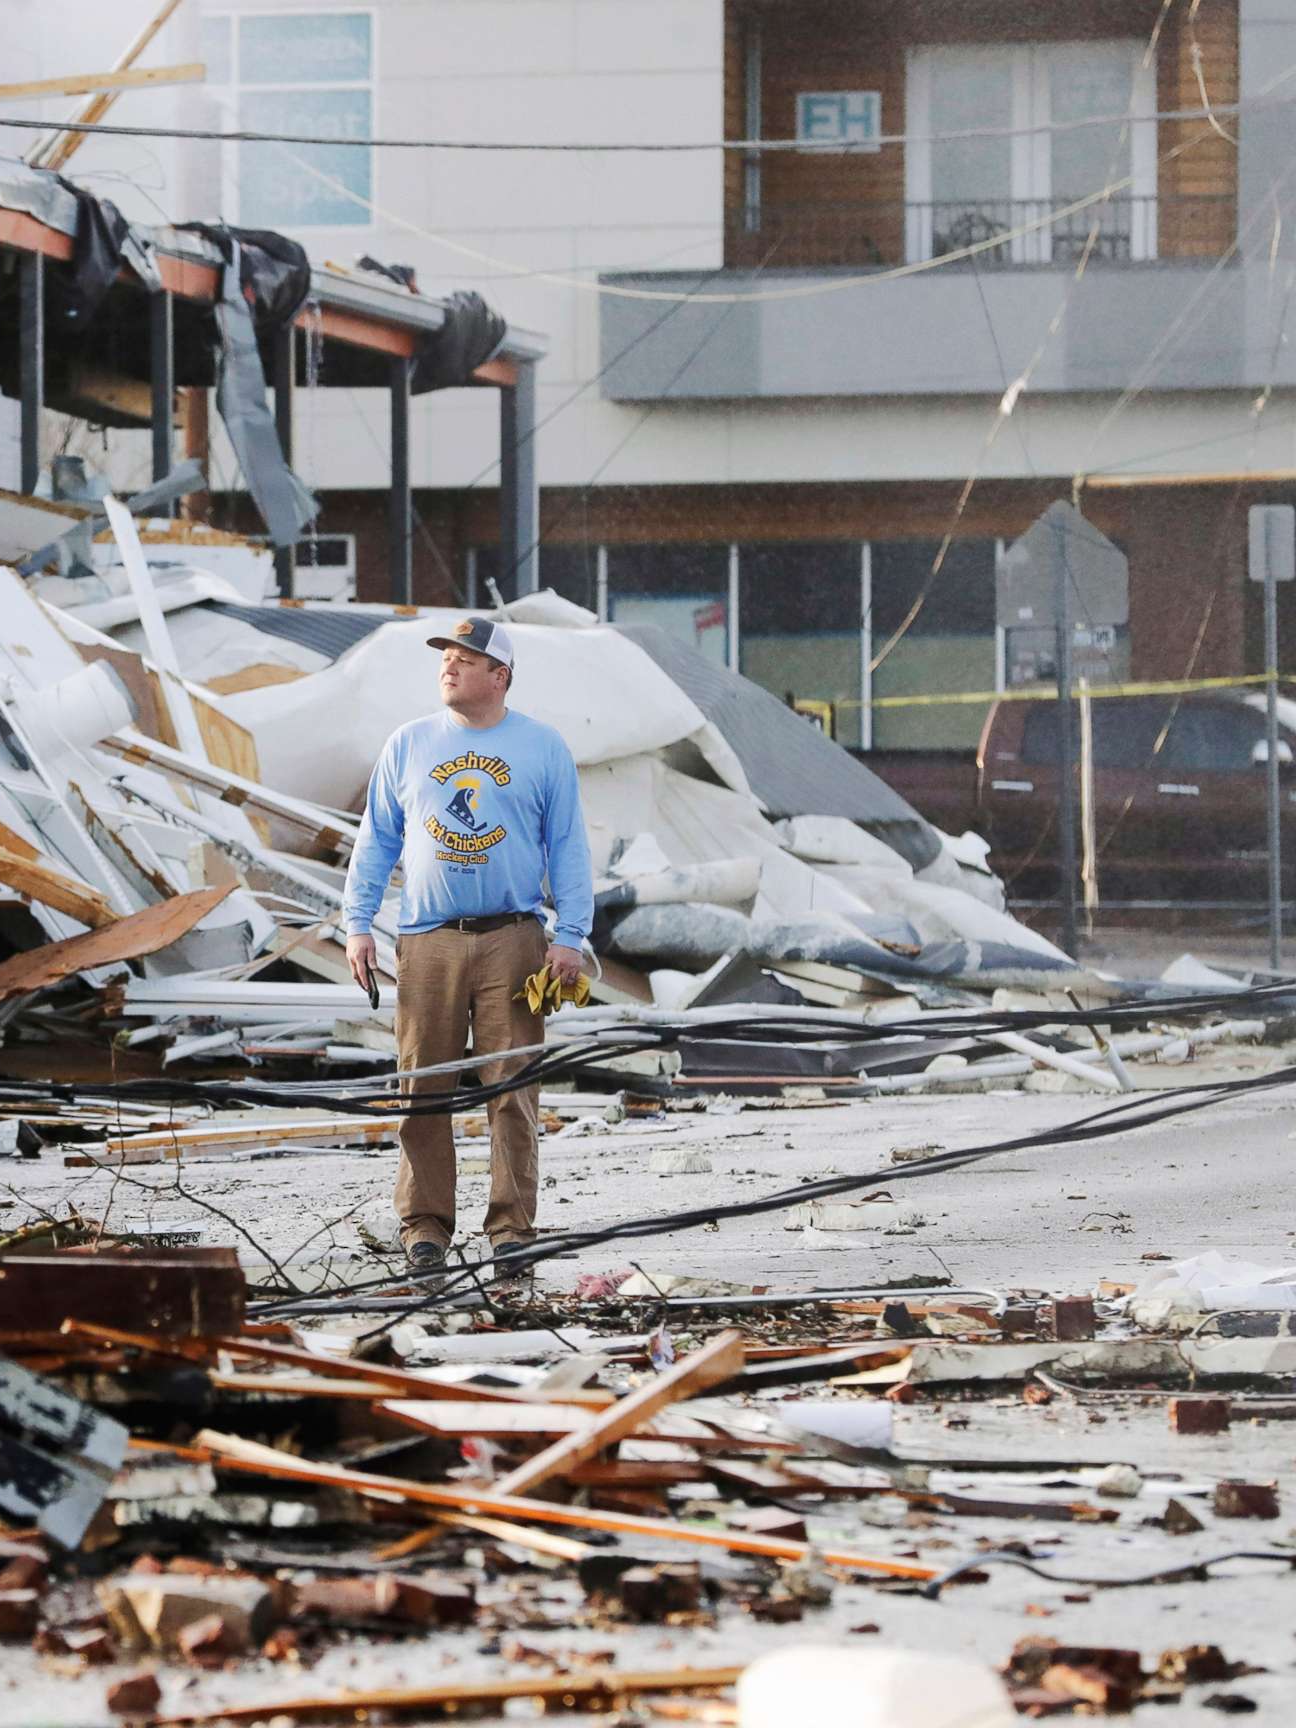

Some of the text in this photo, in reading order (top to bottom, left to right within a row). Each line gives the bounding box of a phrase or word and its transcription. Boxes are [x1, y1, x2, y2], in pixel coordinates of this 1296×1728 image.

[430, 751, 511, 787] Nashville
[424, 815, 506, 852] Hot Chickens
[436, 850, 488, 866] Hockey Club
